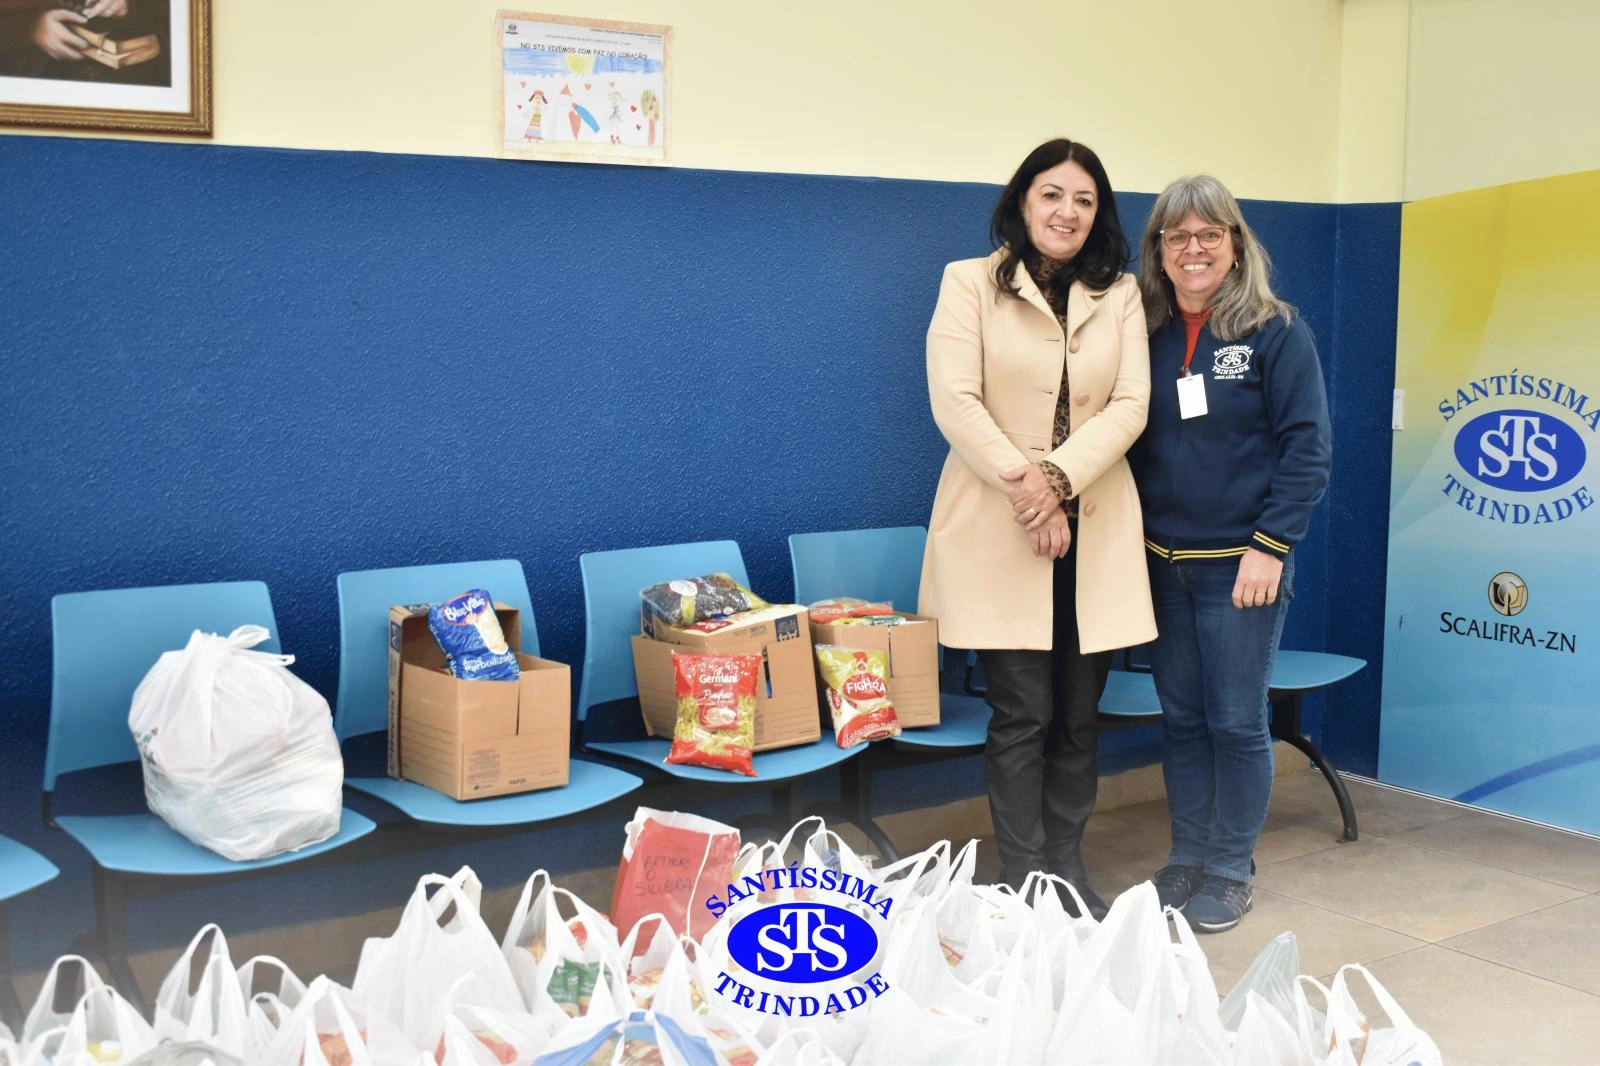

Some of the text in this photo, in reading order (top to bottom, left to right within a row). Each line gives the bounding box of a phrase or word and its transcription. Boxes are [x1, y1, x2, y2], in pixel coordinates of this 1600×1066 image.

[547, 45, 576, 54] VIVEMOS
[1438, 368, 1600, 432] SANTÍSSIMA
[1477, 414, 1558, 481] STS
[1441, 473, 1595, 525] TRINDADE
[1439, 611, 1577, 654] SCALIFRA-ZN
[699, 673, 738, 684] Germani
